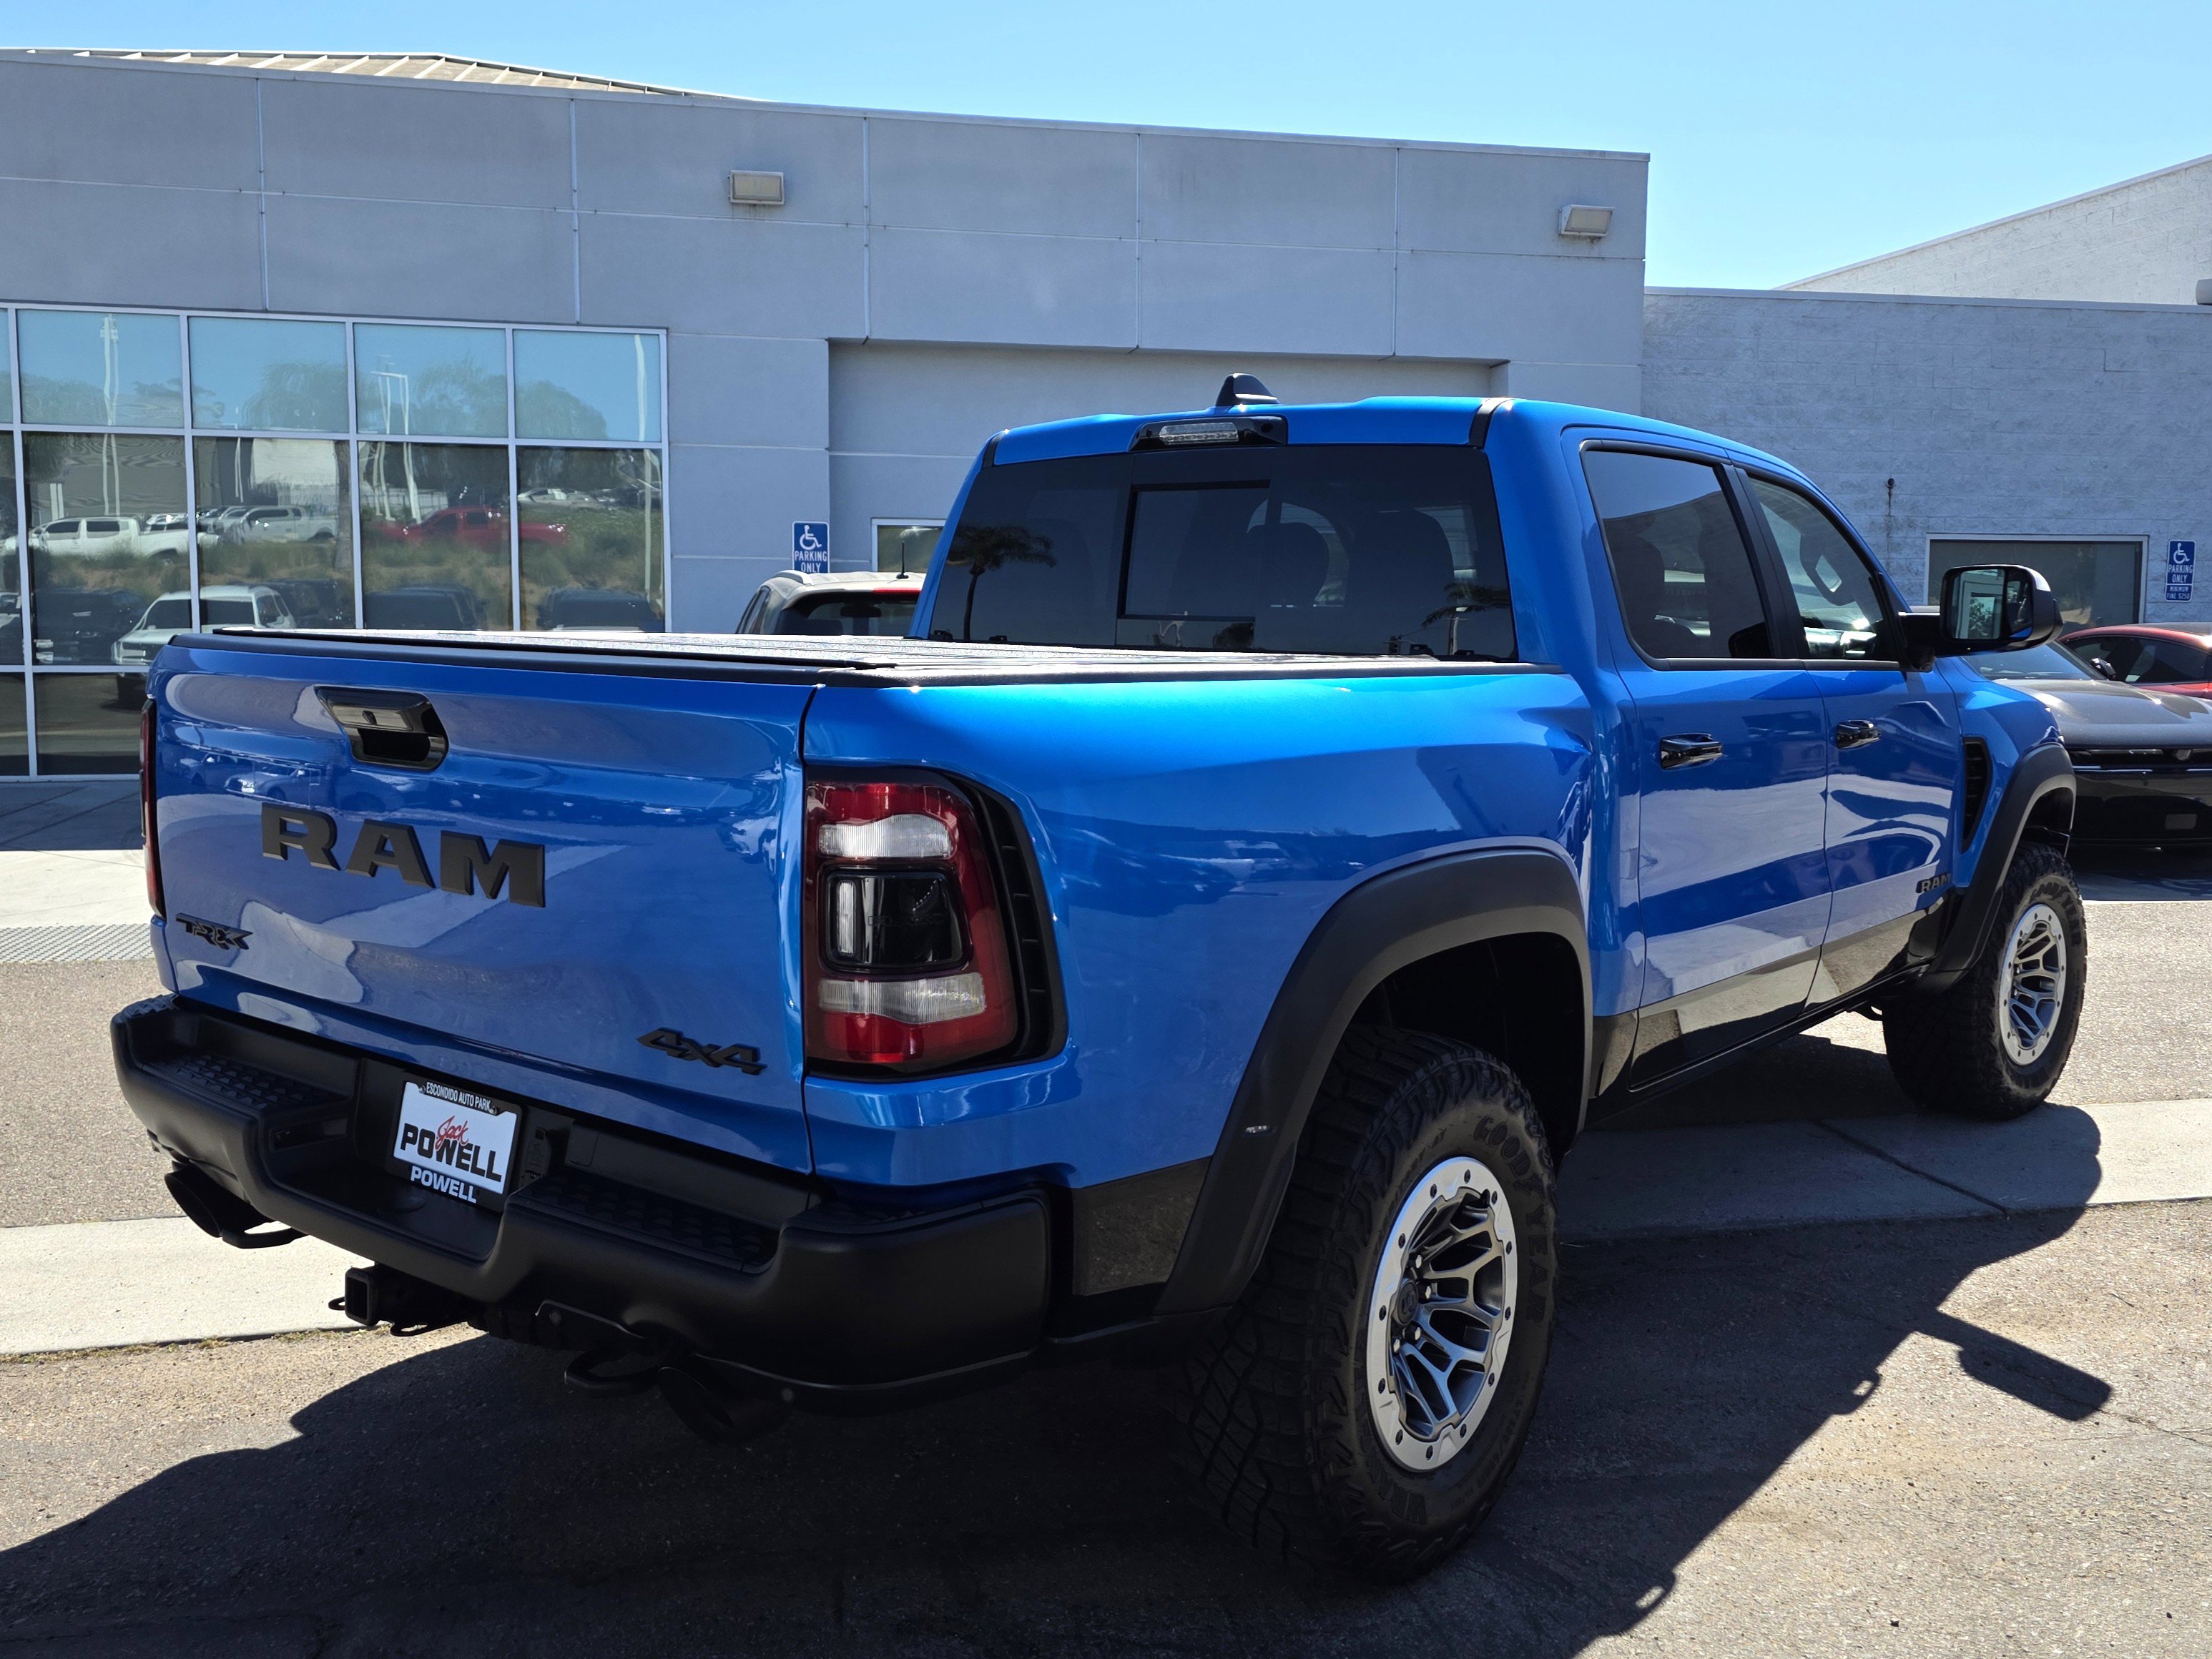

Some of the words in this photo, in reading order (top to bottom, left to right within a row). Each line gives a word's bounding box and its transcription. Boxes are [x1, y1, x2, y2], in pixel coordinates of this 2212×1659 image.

[795, 551, 827, 561] PARKING
[800, 562, 821, 573] ONLY
[2168, 564, 2193, 573] PARKING
[2172, 573, 2188, 583] ONLY
[260, 802, 546, 909] RAM
[1917, 873, 1951, 893] RAM
[426, 1082, 458, 1103] ESCONDIDO
[458, 1091, 475, 1107] AUTO
[475, 1096, 492, 1112] PARK
[435, 1115, 469, 1150] Jack
[400, 1123, 502, 1183] POWELL
[410, 1165, 477, 1203] POWELL
[1474, 1115, 1549, 1323] GOODYEAR
